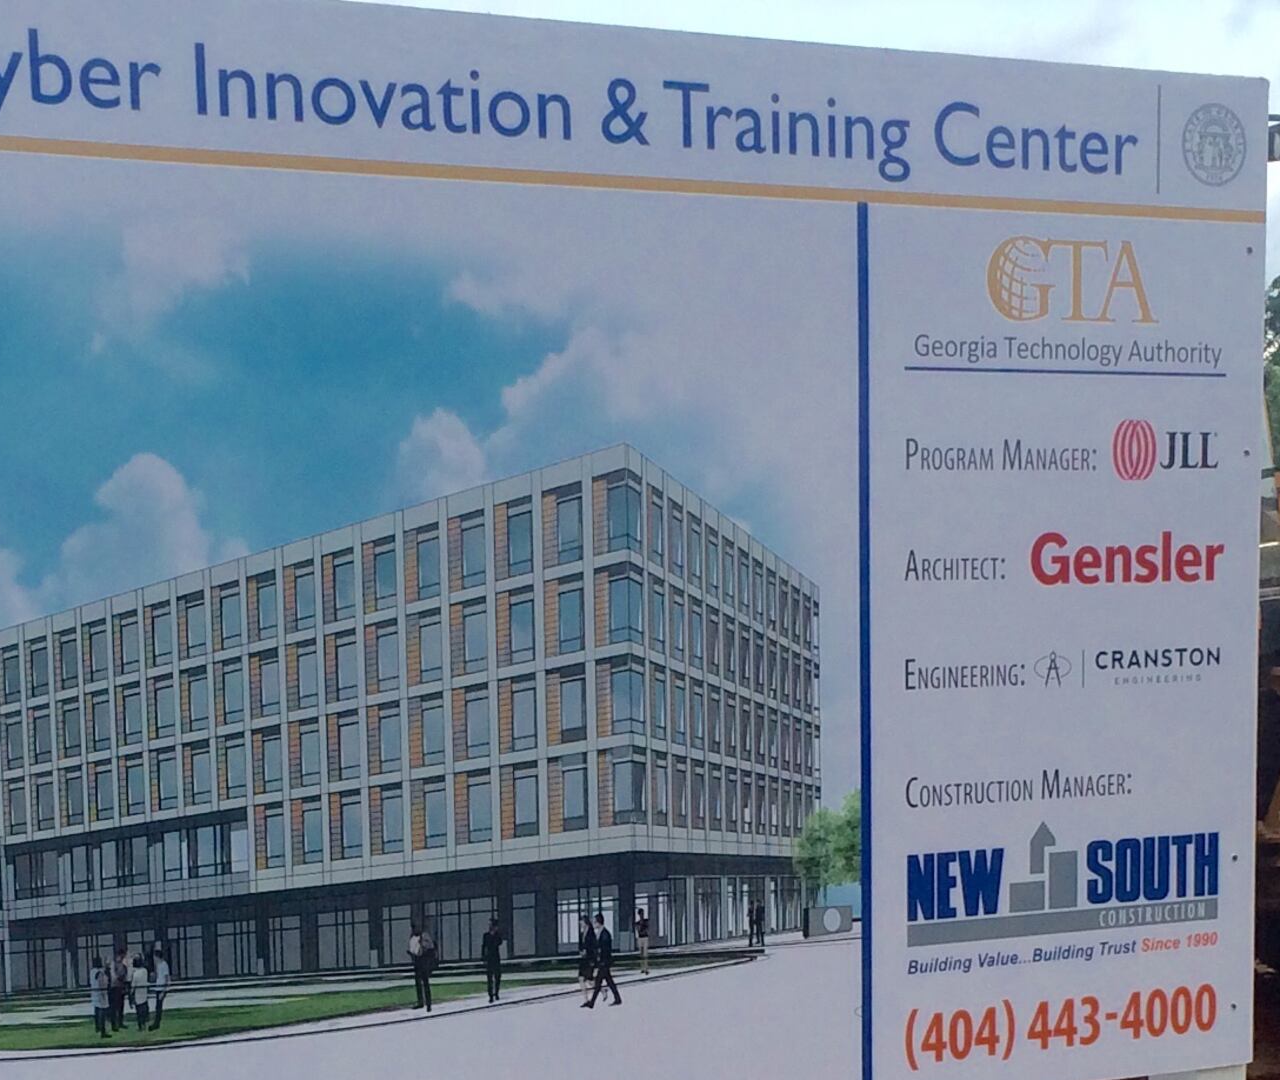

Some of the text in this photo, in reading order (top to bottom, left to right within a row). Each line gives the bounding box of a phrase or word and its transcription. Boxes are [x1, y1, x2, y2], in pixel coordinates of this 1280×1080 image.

[195, 42, 572, 140] Innovation
[601, 78, 649, 146] &
[663, 80, 910, 182] Training
[934, 101, 1138, 175] Center
[986, 236, 1159, 323] GTA
[914, 334, 1222, 369] Georgia Technology Authority
[1160, 432, 1219, 470] JLL
[1030, 531, 1225, 586] Gensler
[1095, 647, 1220, 670] CRANSTON
[906, 832, 1219, 922] NEW SOUTH
[1099, 905, 1206, 927] CONSTRUCTION
[907, 959, 972, 975] Building
[1100, 939, 1137, 956] Trust
[1141, 937, 1181, 953] Since
[1186, 931, 1218, 948] 1990
[905, 983, 1217, 1071] (404) 443-4000
